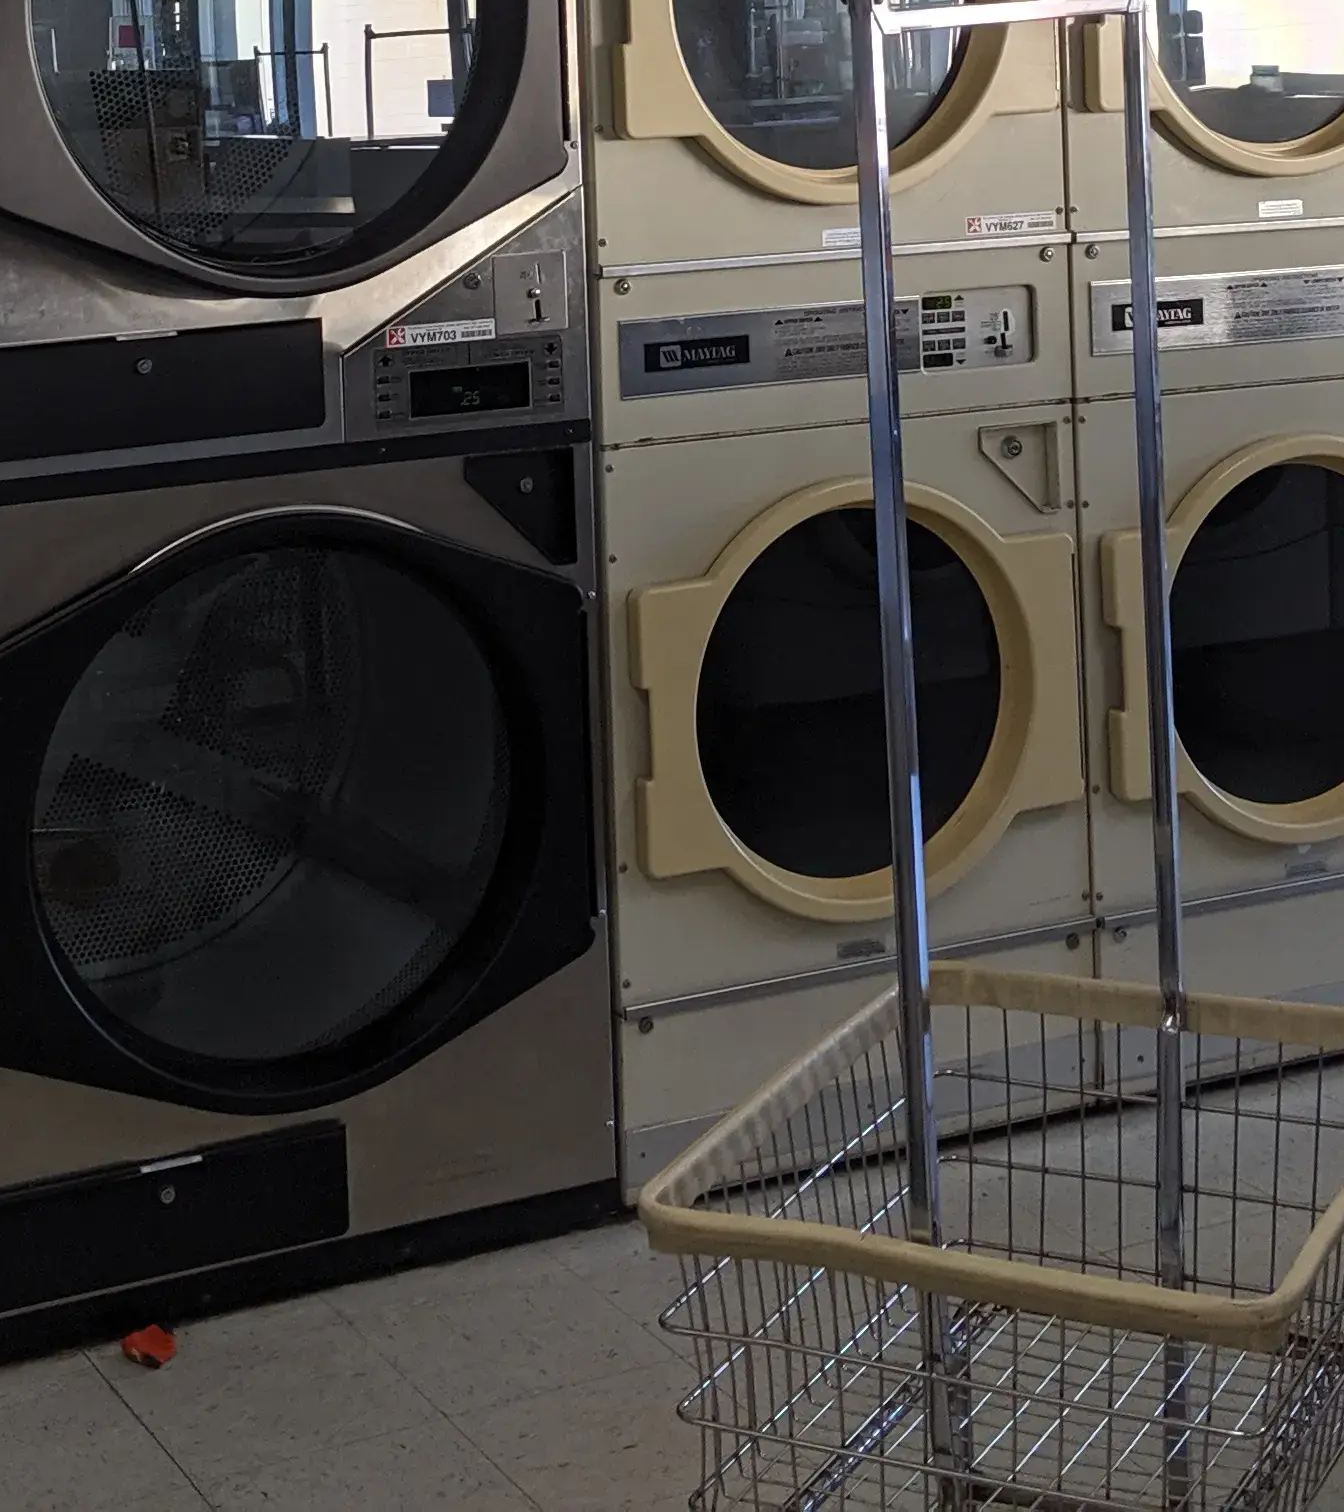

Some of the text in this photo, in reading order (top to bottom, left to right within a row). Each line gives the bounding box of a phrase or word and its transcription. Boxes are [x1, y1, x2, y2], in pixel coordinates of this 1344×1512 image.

[985, 221, 1024, 232] VYM627
[1158, 306, 1192, 322] AYTAG
[411, 331, 456, 343] VYM703
[682, 344, 737, 362] MAYTAG
